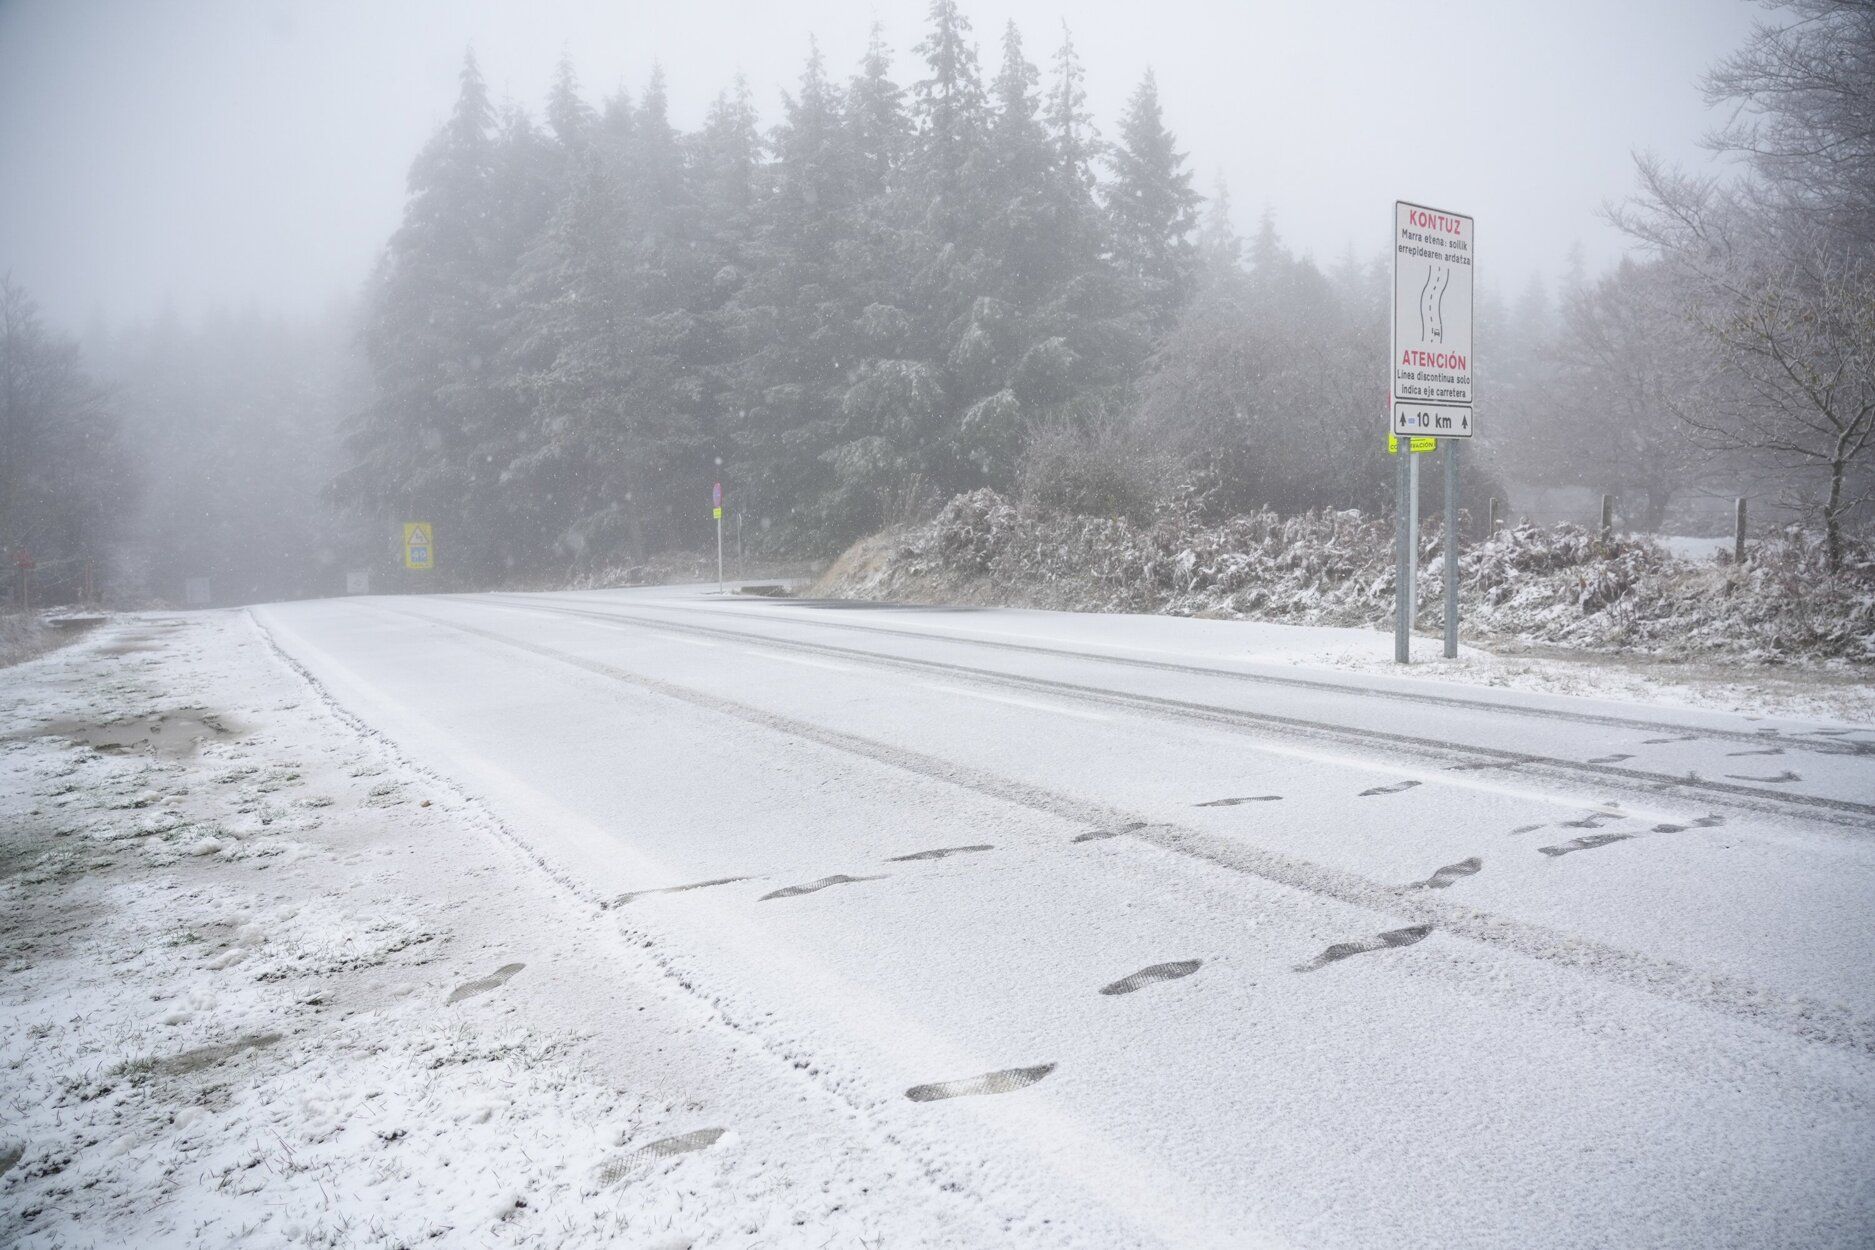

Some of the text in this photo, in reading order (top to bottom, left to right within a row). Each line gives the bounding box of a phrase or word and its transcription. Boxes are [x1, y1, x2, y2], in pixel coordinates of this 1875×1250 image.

[1409, 209, 1461, 235] KONTUZ
[1402, 229, 1422, 242] Marra
[1424, 235, 1447, 247] etena:
[1398, 244, 1471, 265] errepidearen ardatza
[1402, 349, 1466, 370] ATENCIÓN
[1416, 371, 1455, 384] discontinua
[1456, 374, 1470, 385] solo
[1401, 383, 1466, 398] indica eje carretera
[1417, 411, 1452, 429] 10 km
